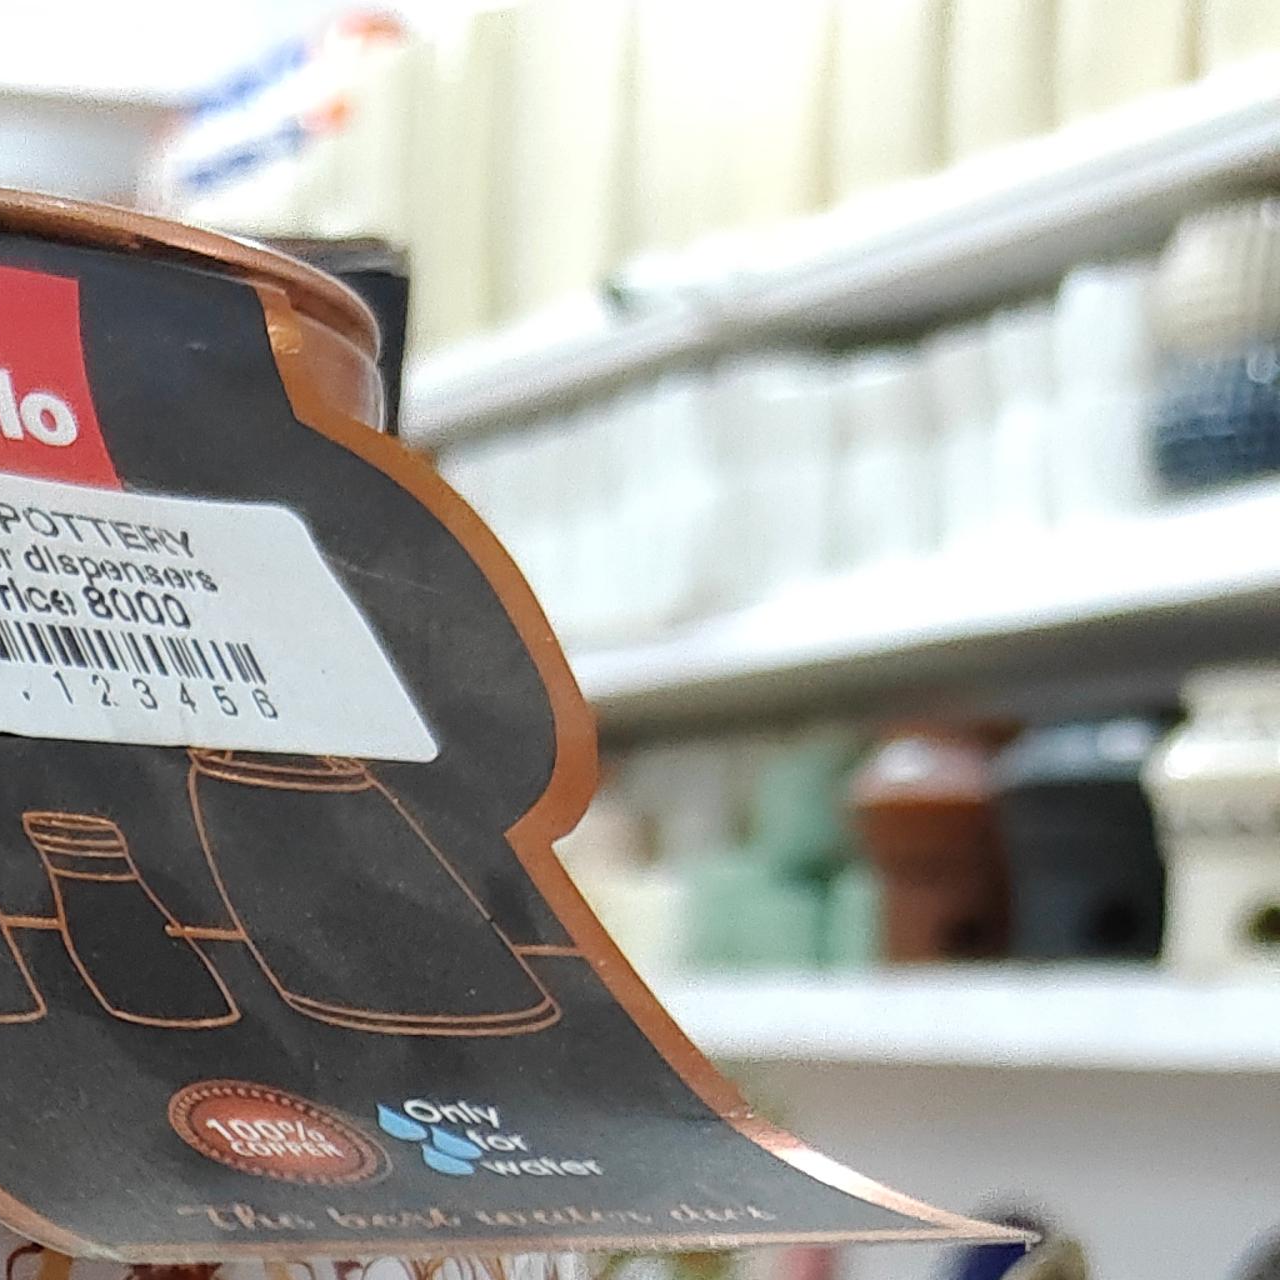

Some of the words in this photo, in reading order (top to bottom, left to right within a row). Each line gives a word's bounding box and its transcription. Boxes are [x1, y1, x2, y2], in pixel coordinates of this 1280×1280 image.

[24, 543, 220, 594] dispensers
[81, 585, 193, 630] 8000
[402, 1098, 502, 1130] Only
[206, 1117, 327, 1144] 100%
[467, 1129, 529, 1153] for
[231, 1141, 345, 1159] COPPER
[480, 1155, 606, 1179] water
